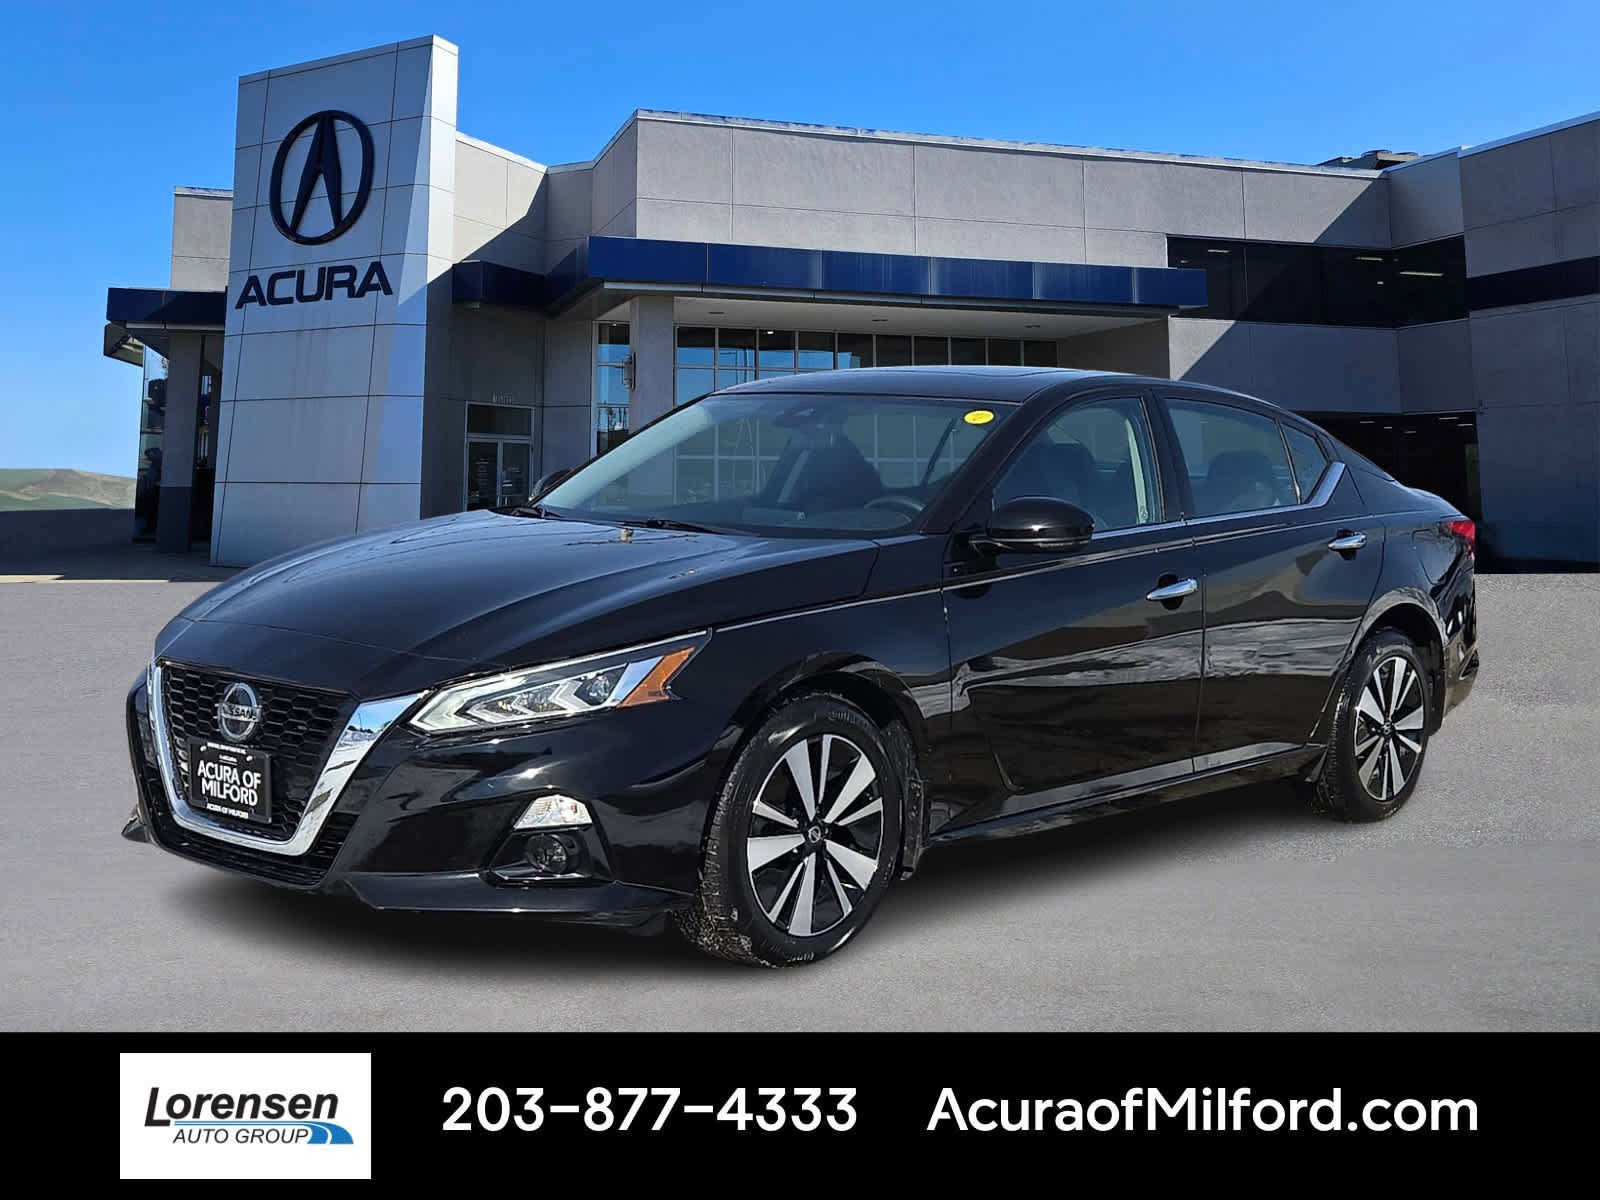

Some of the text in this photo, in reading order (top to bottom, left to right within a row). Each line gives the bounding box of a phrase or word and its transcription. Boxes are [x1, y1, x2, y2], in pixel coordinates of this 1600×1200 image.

[235, 261, 393, 309] ACURA
[197, 760, 261, 789] ACURA OF
[202, 777, 258, 806] MILFORD
